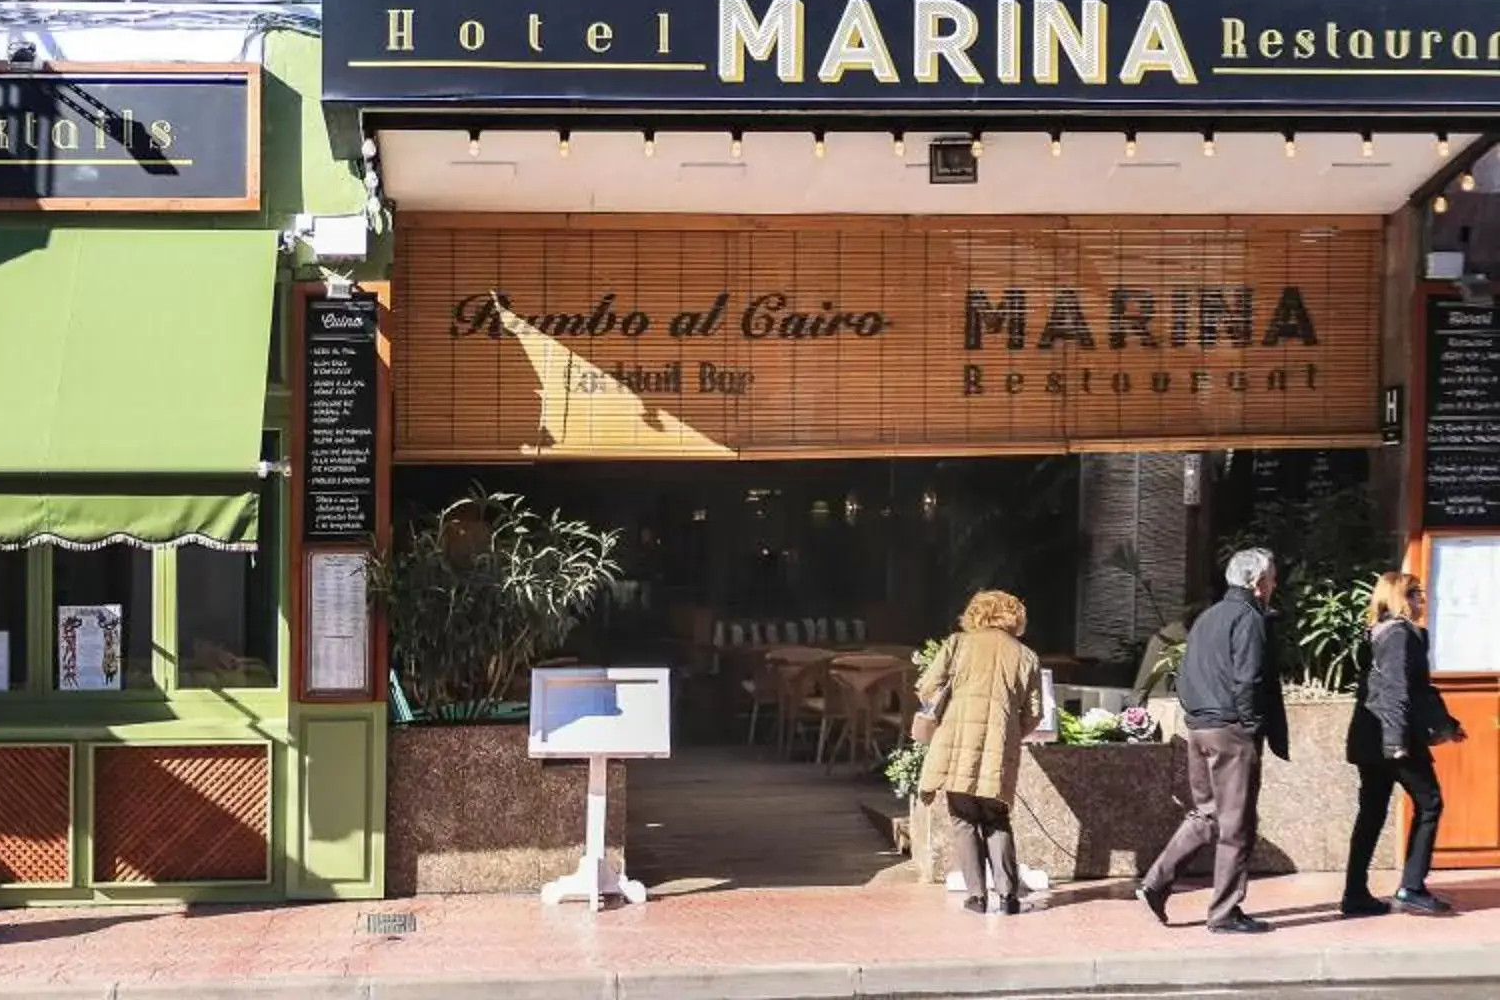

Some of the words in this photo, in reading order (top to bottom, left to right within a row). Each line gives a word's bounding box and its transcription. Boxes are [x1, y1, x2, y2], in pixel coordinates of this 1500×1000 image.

[385, 8, 670, 52] Hotel
[450, 289, 650, 340] Rumbo
[668, 291, 730, 340] al
[741, 290, 892, 340] Cairo
[963, 284, 1319, 351] MARINA
[963, 363, 1319, 396] Restaurant
